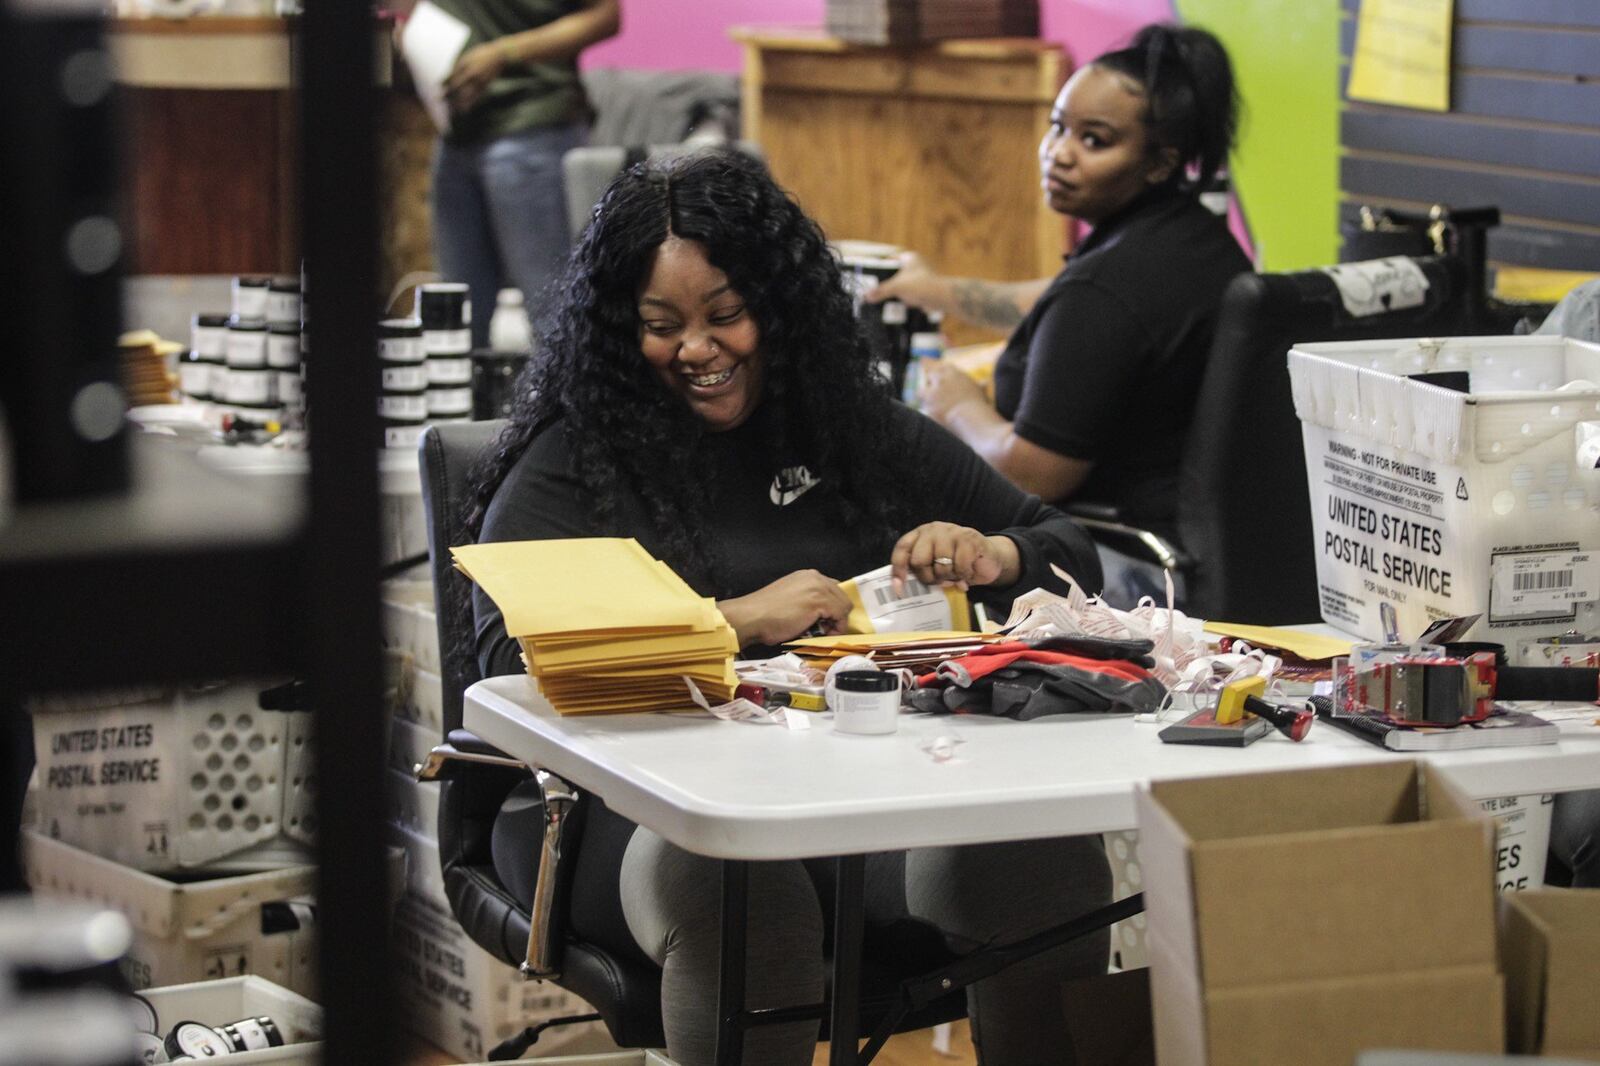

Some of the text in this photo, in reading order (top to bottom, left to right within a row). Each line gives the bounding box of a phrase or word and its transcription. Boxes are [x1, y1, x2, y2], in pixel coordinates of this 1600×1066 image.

[1328, 440, 1356, 460] WARNING
[1361, 451, 1375, 465] NOT
[1376, 456, 1390, 470] FOR
[1391, 461, 1420, 480] PRIVATE
[1421, 469, 1437, 485] USE
[1328, 494, 1377, 535] UNITED
[1381, 513, 1442, 556] STATES
[1325, 530, 1451, 598] POSTAL SERVICE
[52, 724, 154, 755] UNITED STATES
[47, 758, 160, 790] POSTAL SERVICE
[1499, 797, 1518, 809] USE
